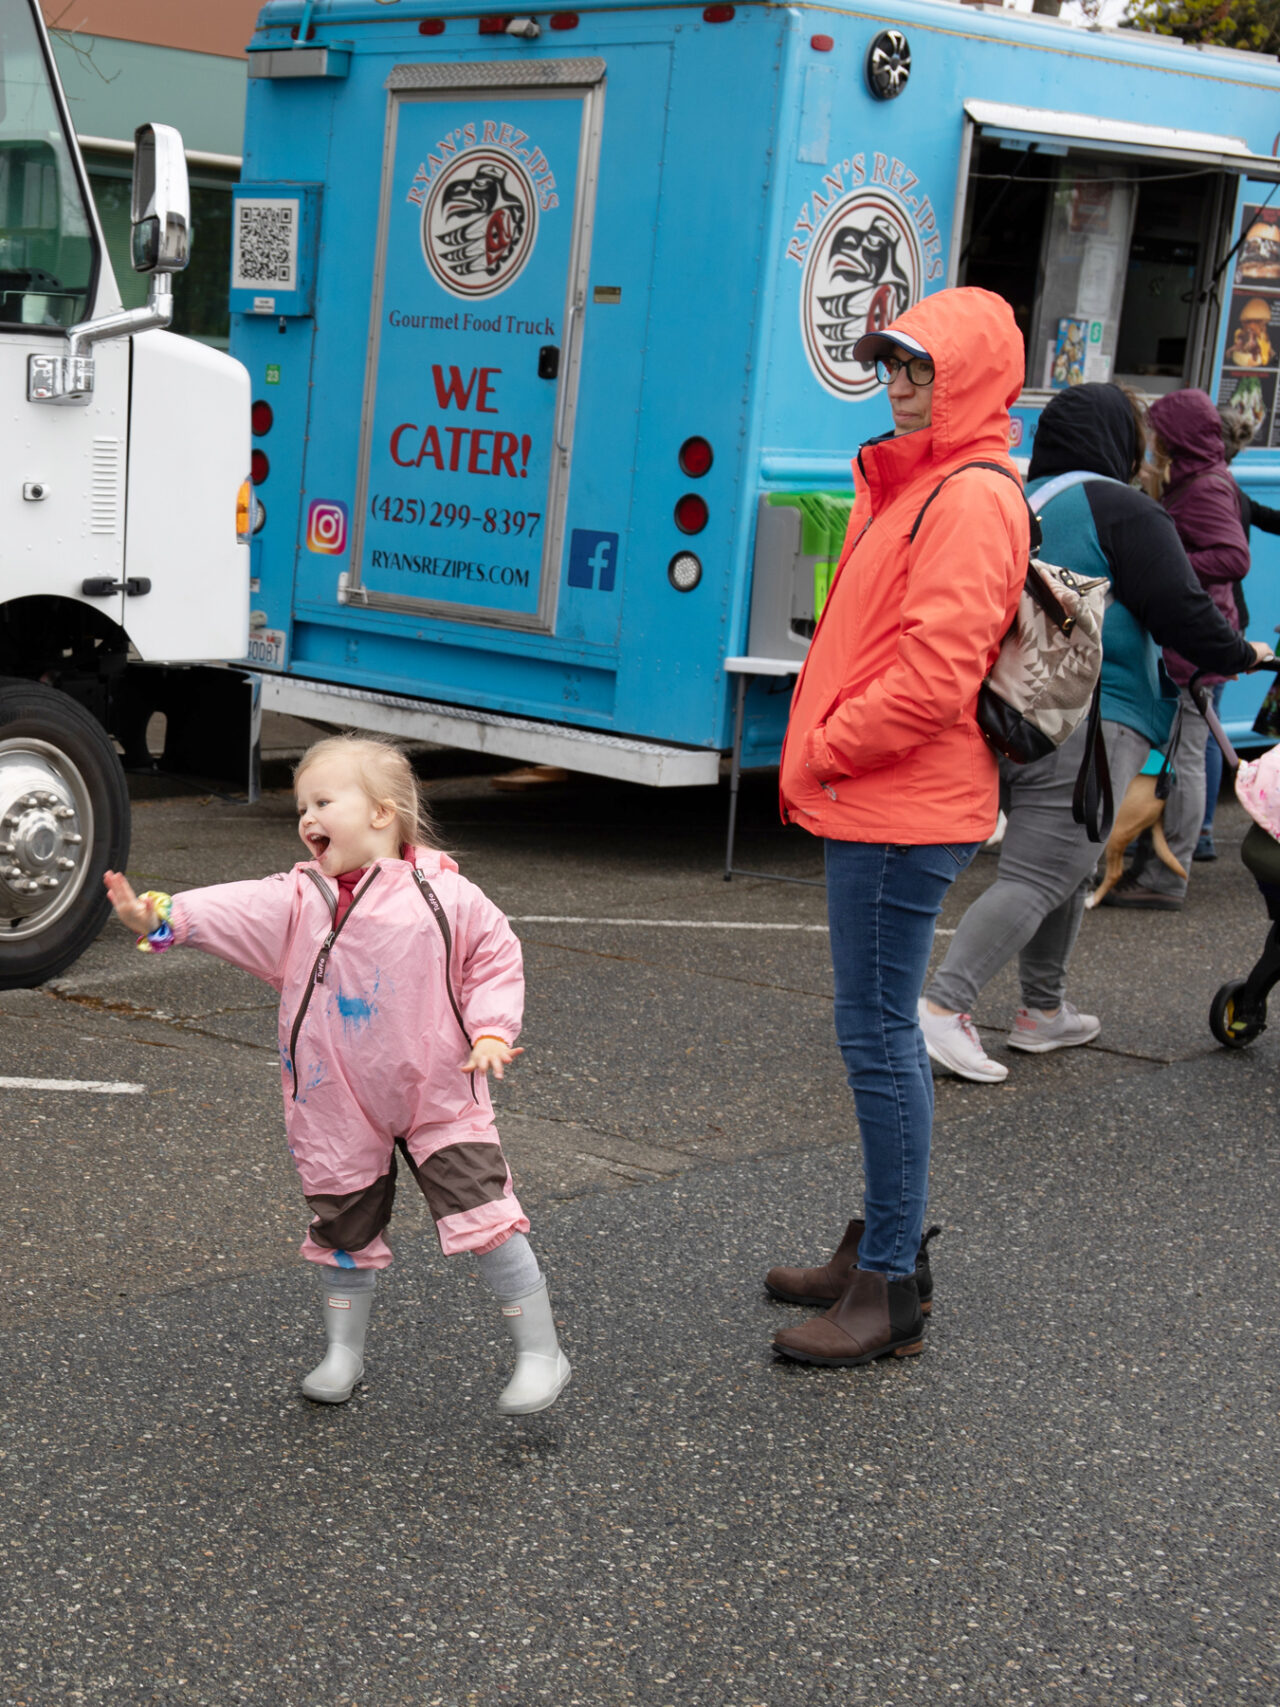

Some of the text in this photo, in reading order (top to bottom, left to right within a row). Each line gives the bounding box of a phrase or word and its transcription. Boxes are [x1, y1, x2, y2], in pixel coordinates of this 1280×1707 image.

[406, 120, 560, 211] RYAN'S REZ-IPES
[785, 152, 866, 268] RYAN'S
[871, 151, 944, 281] REZ-IPES
[389, 310, 555, 336] Gourmet Food Truck
[431, 364, 502, 413] WE
[389, 423, 532, 478] CATER!
[371, 494, 541, 538] (425) 299-8397
[371, 550, 530, 588] RYANSREZIPES.COM
